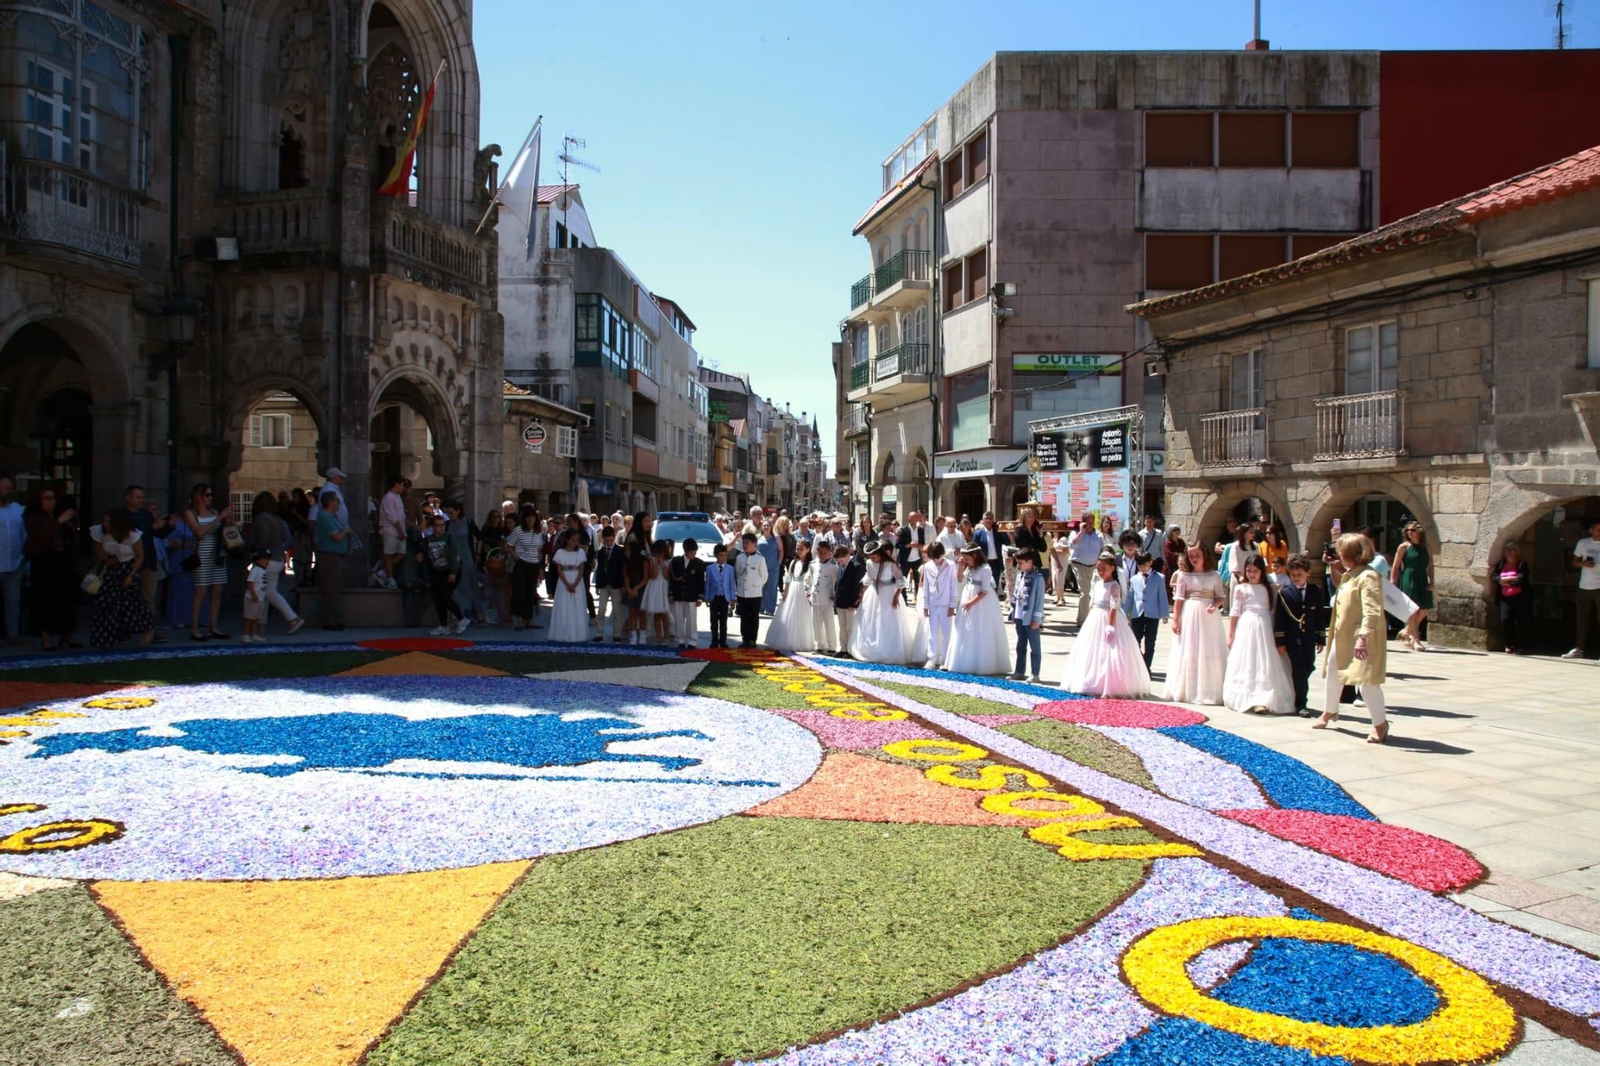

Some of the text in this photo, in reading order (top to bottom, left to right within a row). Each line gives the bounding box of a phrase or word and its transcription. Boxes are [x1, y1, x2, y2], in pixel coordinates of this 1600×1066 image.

[1037, 355, 1101, 365] OUTLET
[1101, 428, 1122, 438] Antonio
[955, 458, 978, 472] Parada
